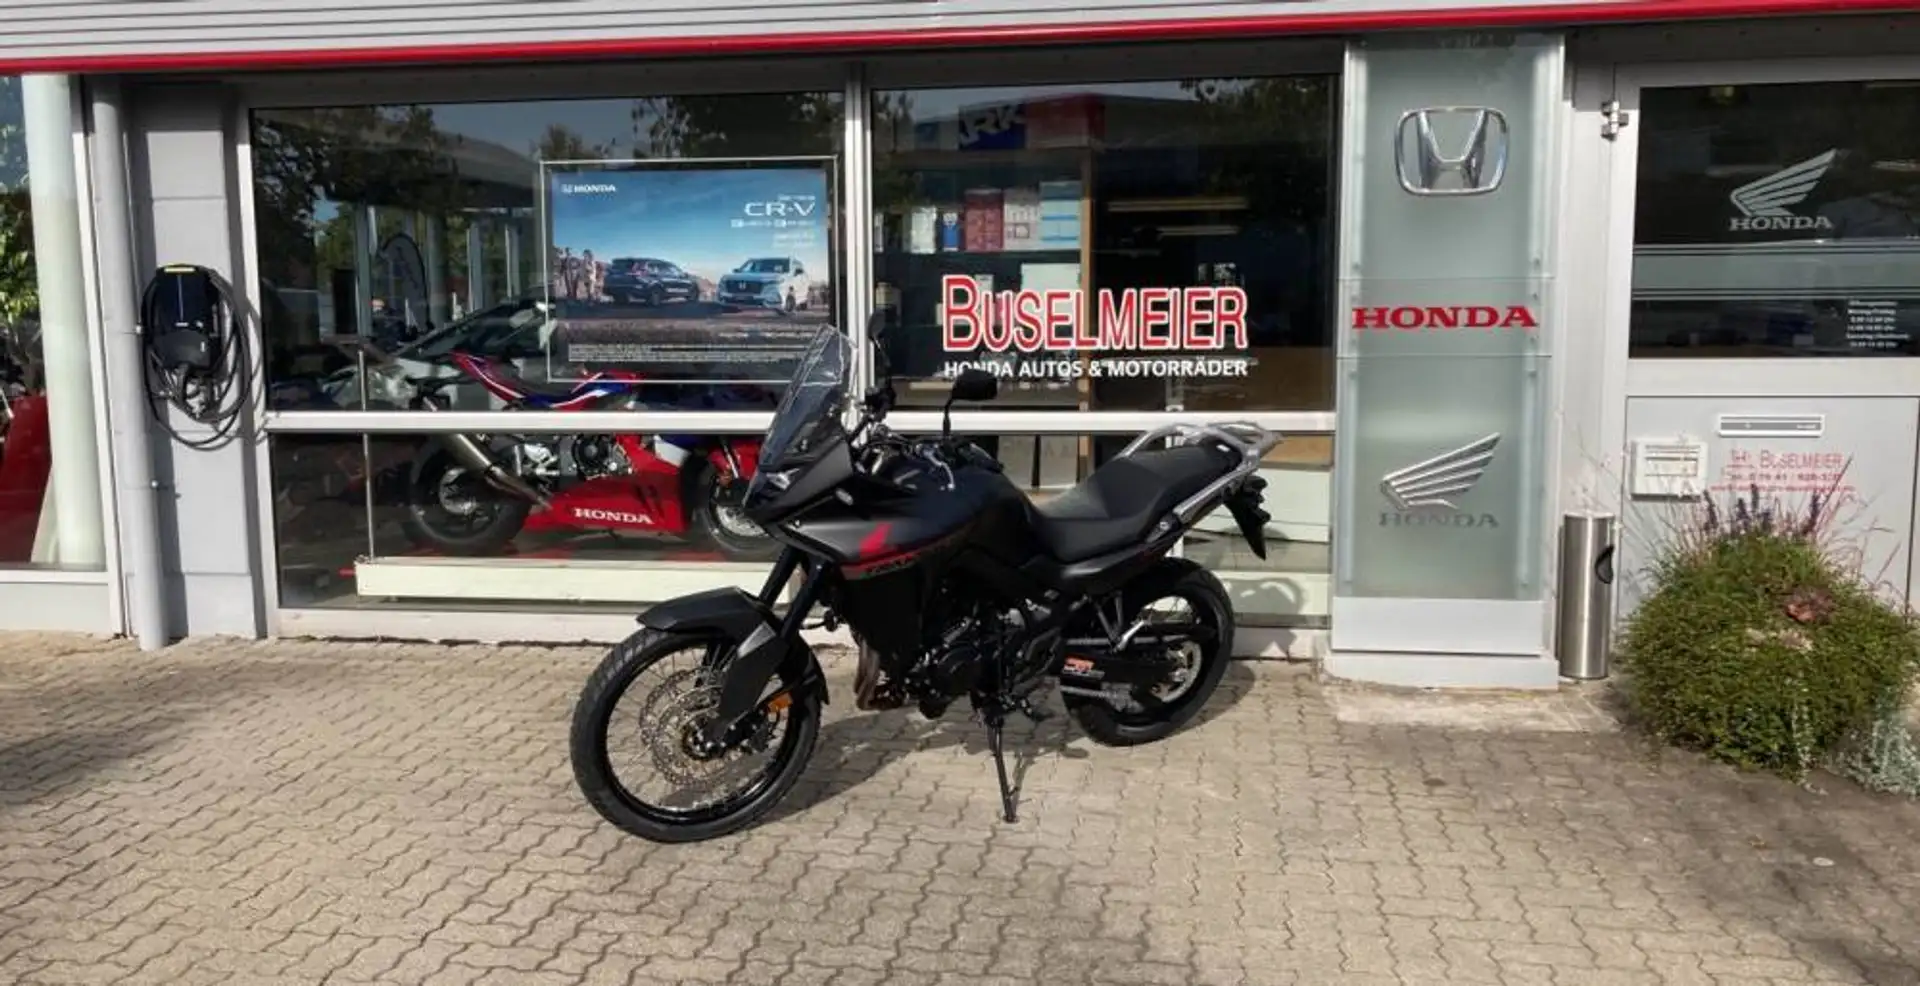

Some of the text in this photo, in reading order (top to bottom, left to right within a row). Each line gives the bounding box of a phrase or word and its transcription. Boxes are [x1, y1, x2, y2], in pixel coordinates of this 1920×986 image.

[574, 184, 616, 193] HONDA
[1729, 216, 1833, 231] HONDA
[942, 274, 1248, 352] BUSELMEIER
[1351, 306, 1540, 329] HONDA
[1018, 360, 1083, 377] AUTOS
[1088, 361, 1102, 377] &
[1107, 356, 1248, 377] MOTORRÄDER
[573, 507, 655, 525] HONDA
[1379, 512, 1500, 528] HONDA
